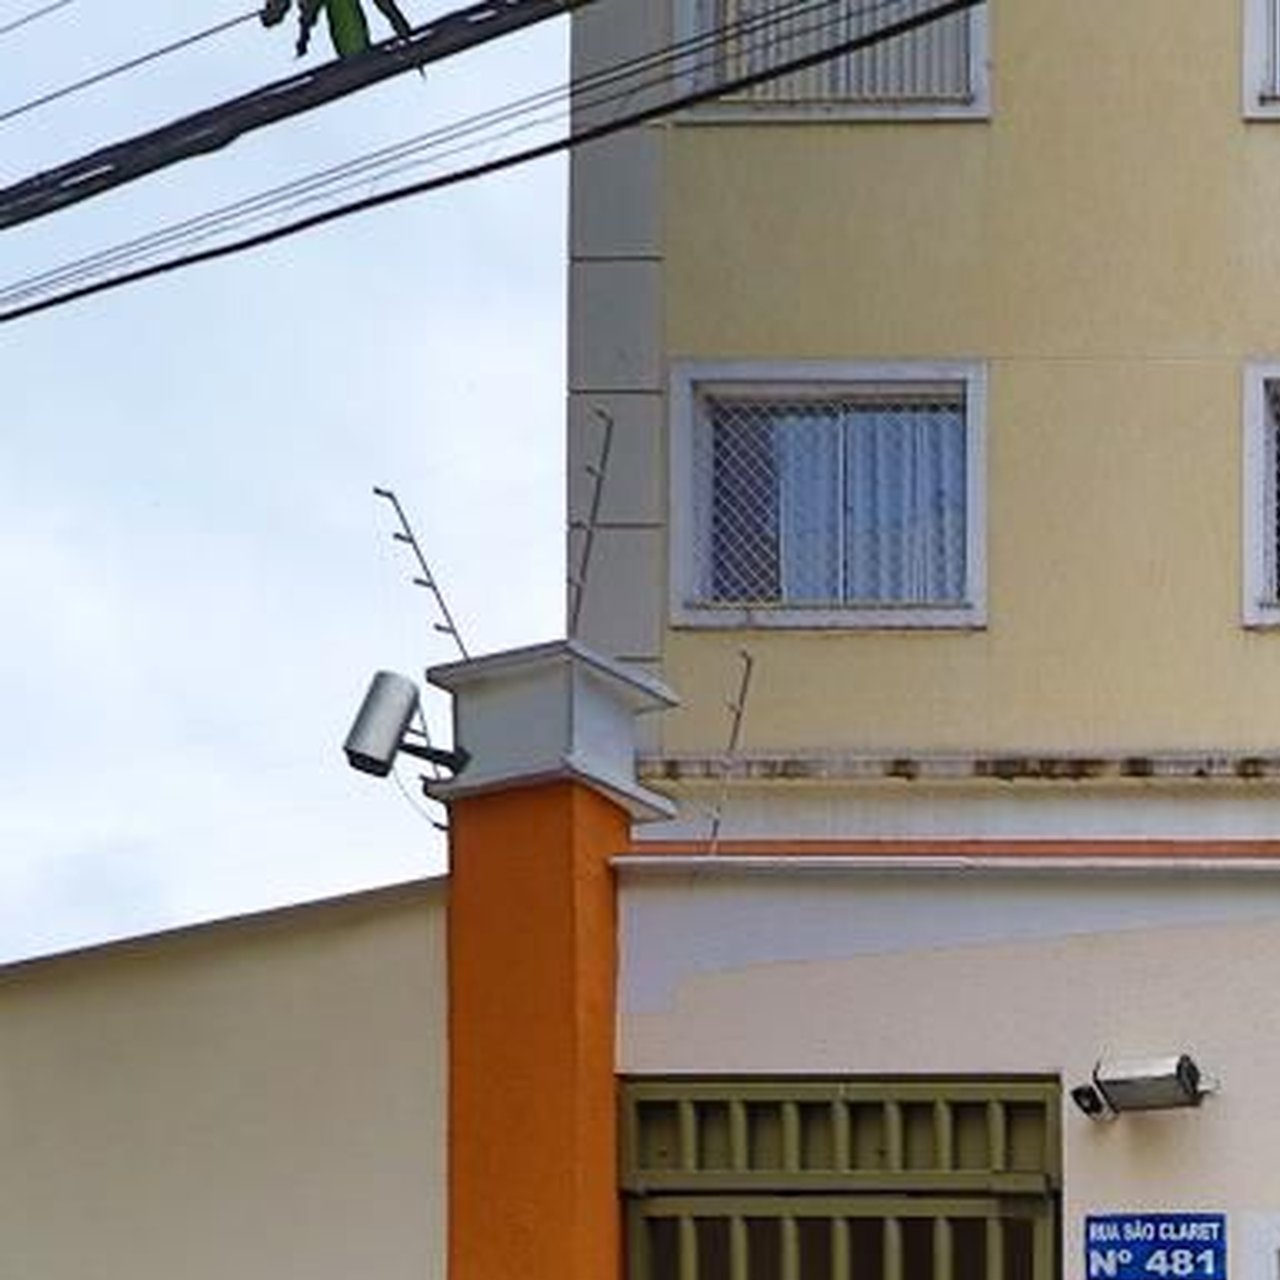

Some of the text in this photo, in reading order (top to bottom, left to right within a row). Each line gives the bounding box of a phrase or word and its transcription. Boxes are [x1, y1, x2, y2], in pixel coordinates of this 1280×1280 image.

[1089, 1218, 1221, 1242] RUA SÃO CLARET
[1145, 1248, 1216, 1278] 481
